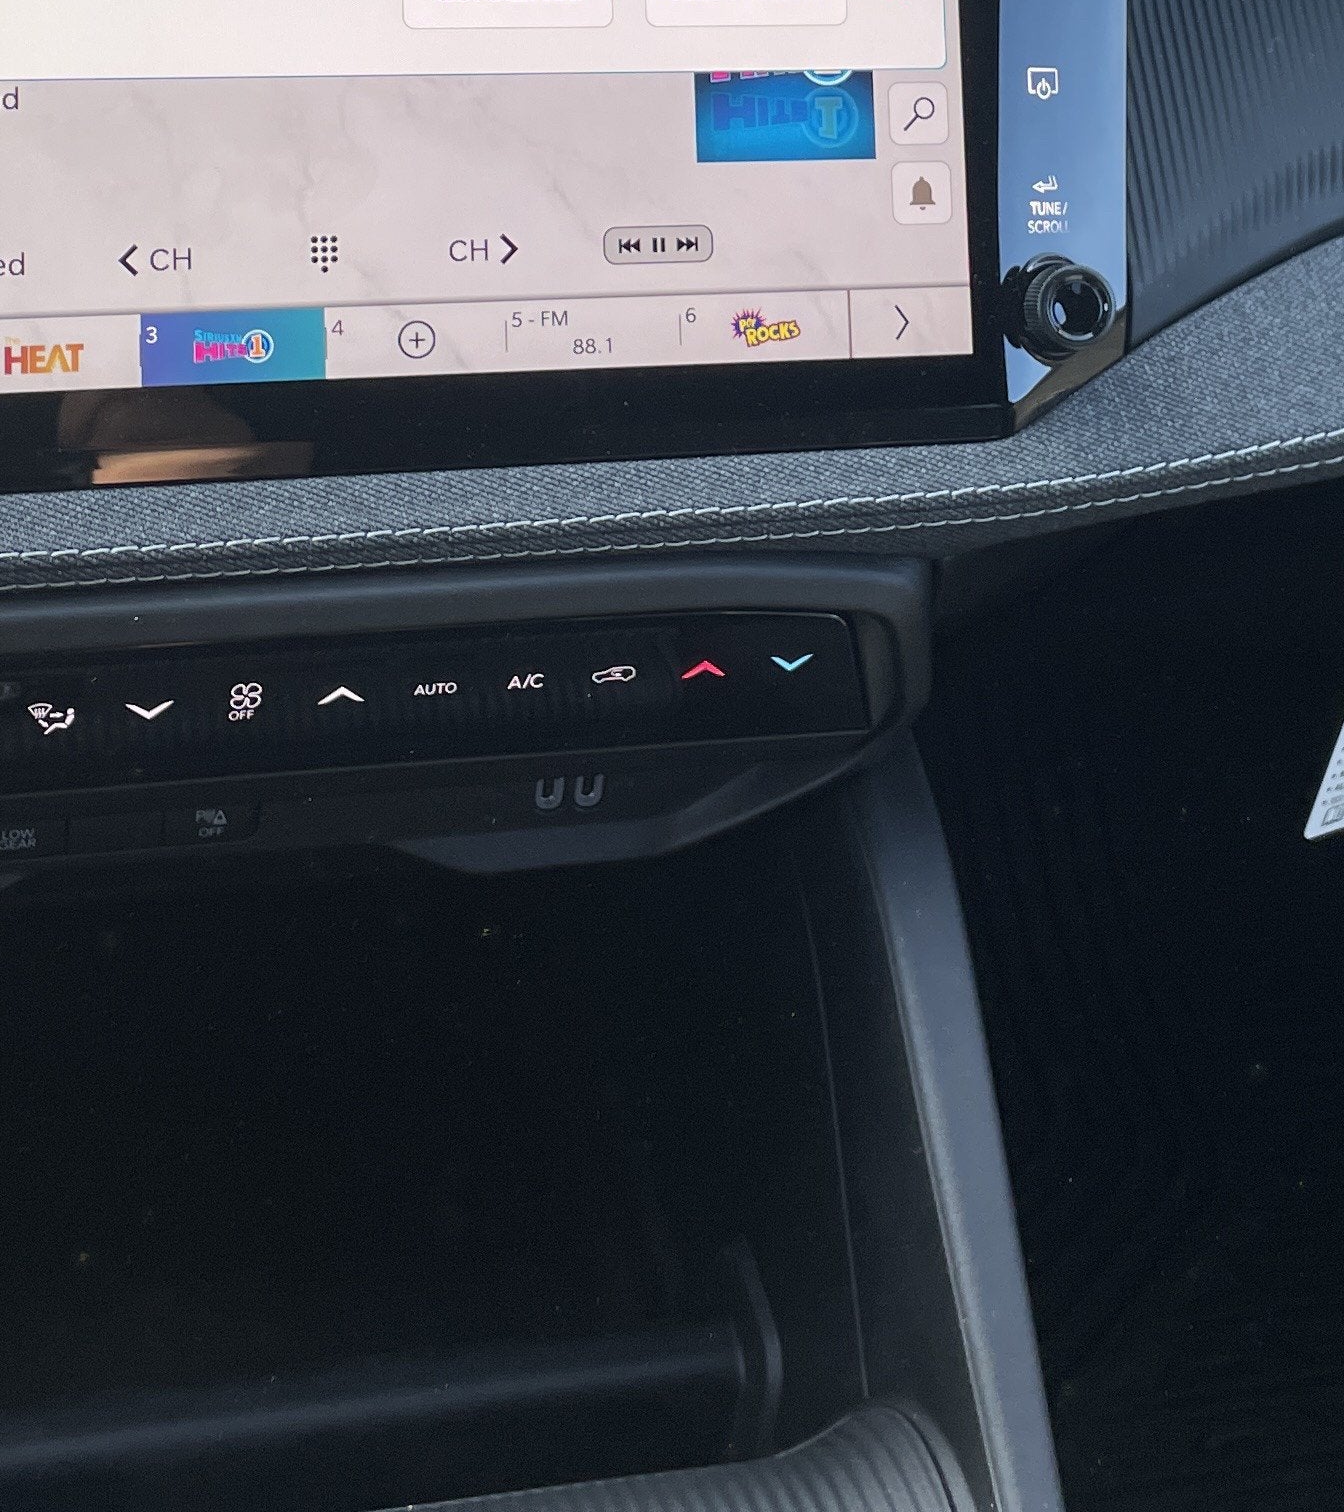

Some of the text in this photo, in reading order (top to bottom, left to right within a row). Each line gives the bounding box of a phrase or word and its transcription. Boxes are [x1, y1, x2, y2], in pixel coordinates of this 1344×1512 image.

[1029, 201, 1068, 216] TUNE/
[1027, 220, 1070, 234] SCROLL
[150, 246, 193, 273] CH
[449, 239, 490, 263] CH
[511, 310, 522, 329] 5
[540, 310, 569, 327] FM
[685, 307, 697, 325] 6
[145, 326, 158, 344] 3
[331, 319, 345, 337] 4
[746, 320, 801, 348] ROCKS
[193, 334, 266, 364] HITS 1
[572, 337, 614, 355] 88.1
[3, 342, 84, 375] HEAT
[414, 681, 458, 698] AUTO
[507, 672, 545, 691] A/C
[228, 708, 255, 723] OFF
[2, 828, 35, 841] LOW
[198, 826, 225, 838] OFF
